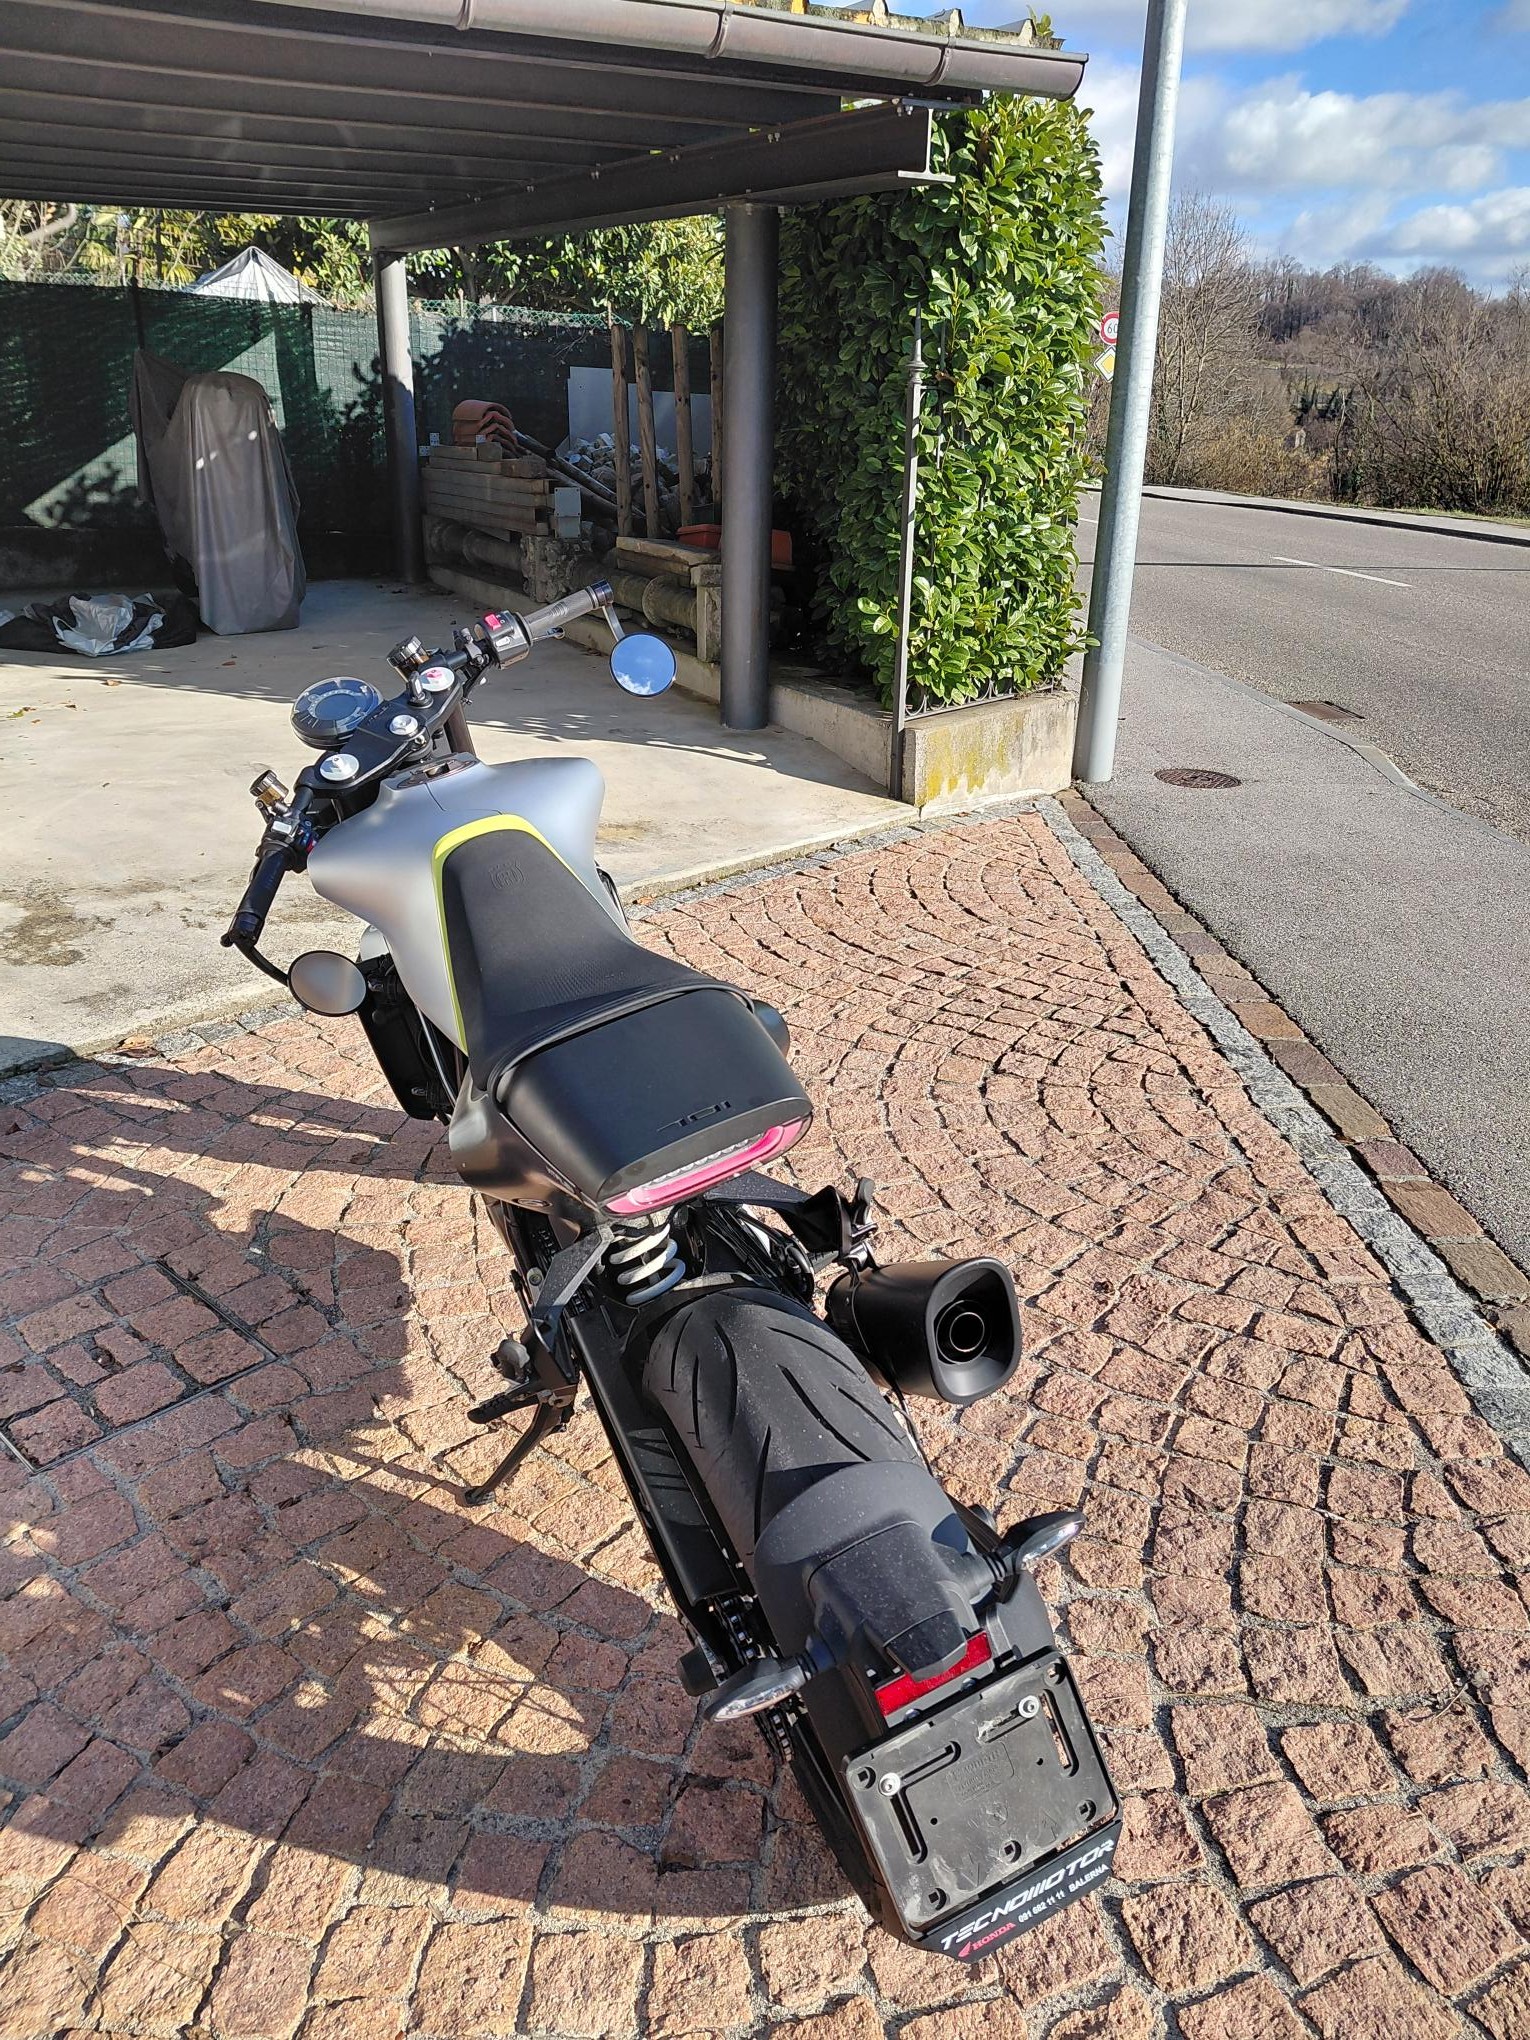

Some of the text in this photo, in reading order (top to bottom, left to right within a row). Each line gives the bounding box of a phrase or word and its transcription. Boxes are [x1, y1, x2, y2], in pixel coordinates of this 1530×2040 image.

[941, 1839, 1115, 1951] TECNOMOTOR
[1047, 1896, 1056, 1906] 11
[1056, 1889, 1065, 1900] 11
[1068, 1863, 1110, 1893] BALERNA
[972, 1922, 1016, 1951] HONDA
